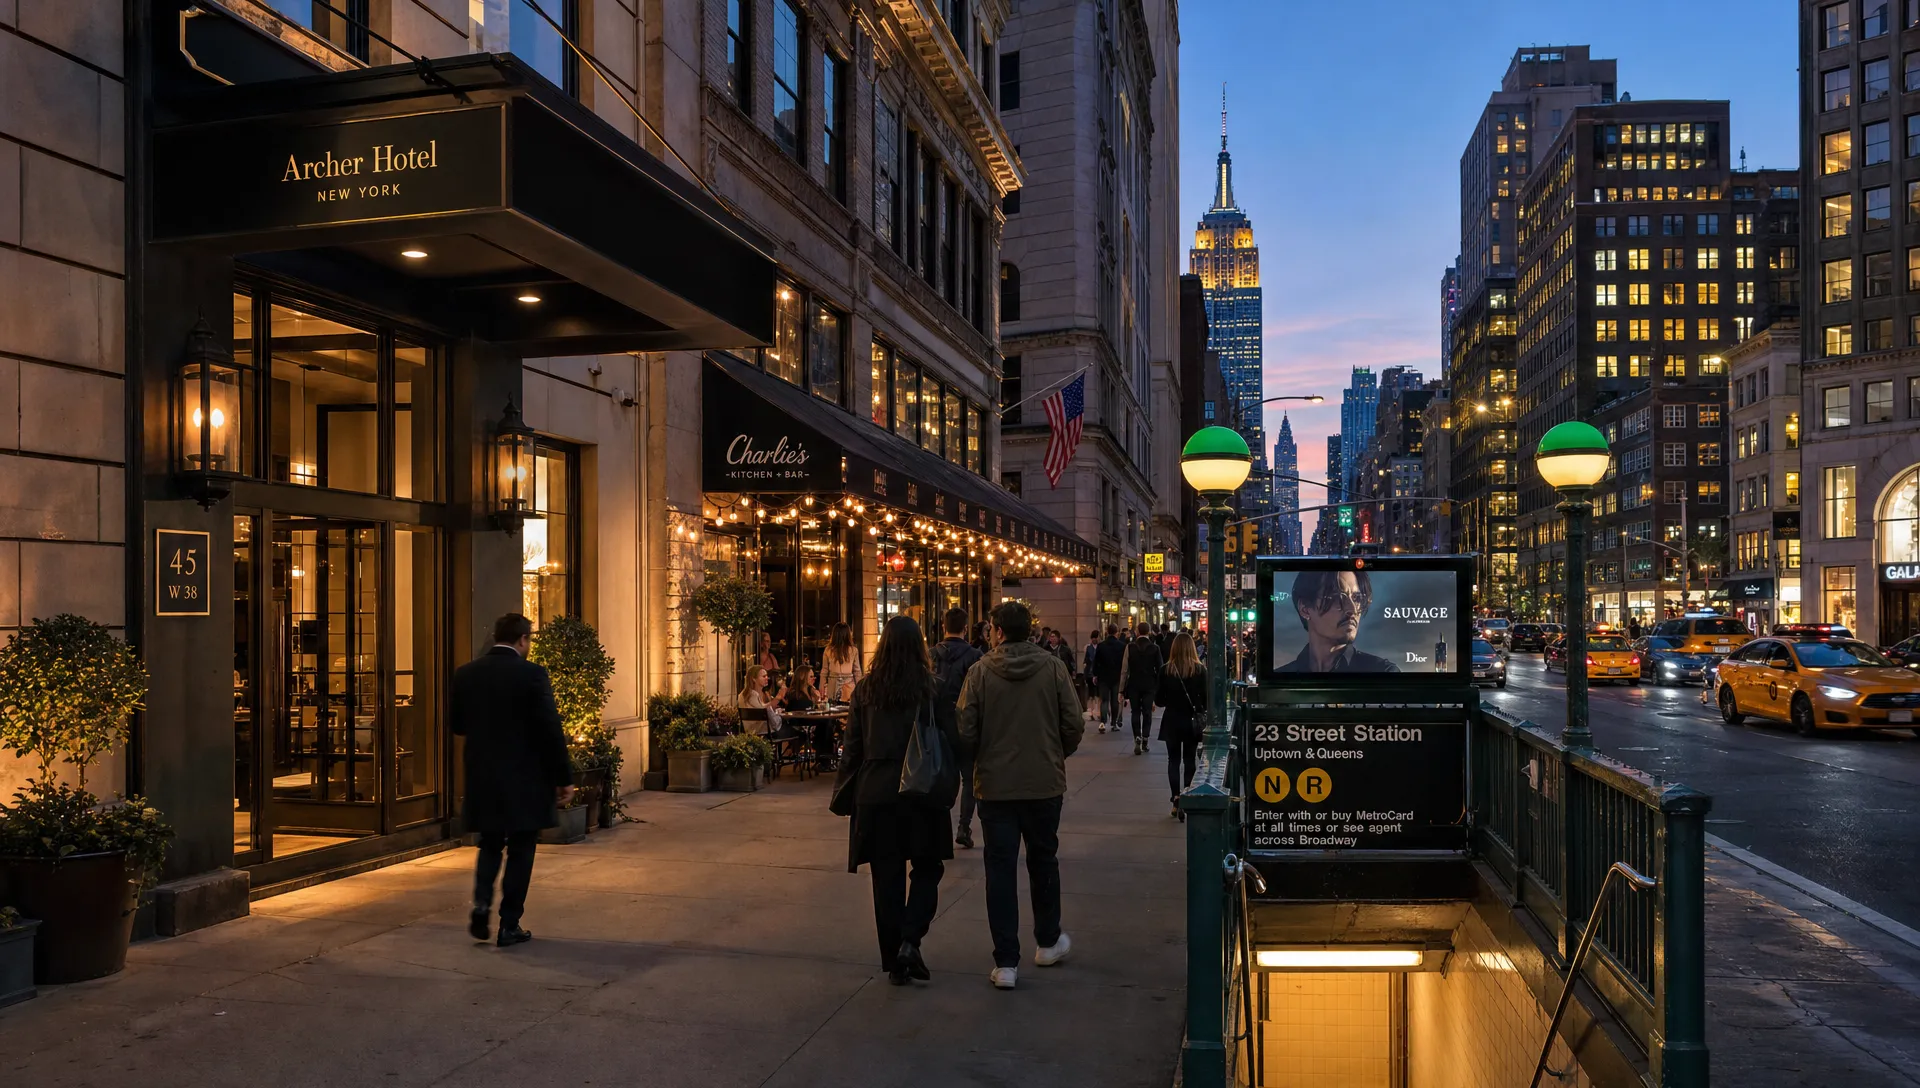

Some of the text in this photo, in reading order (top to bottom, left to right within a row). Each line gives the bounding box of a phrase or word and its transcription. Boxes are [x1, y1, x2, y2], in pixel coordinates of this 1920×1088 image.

[281, 140, 438, 182] Archer Hotel
[317, 183, 400, 202] NEW YORK
[726, 434, 810, 465] Charlie's
[169, 548, 197, 576] 45
[168, 585, 198, 600] W 38
[1383, 606, 1448, 619] SAUVAGE
[1405, 651, 1428, 663] Dior
[1254, 724, 1422, 742] 23 Street Station
[1254, 747, 1364, 760] Uptown & Queens
[1264, 775, 1323, 794] N R
[1254, 809, 1414, 822] Enter with or buy MetroCard
[1254, 822, 1402, 834] at all times or see agent
[1254, 835, 1358, 847] across Broadway
